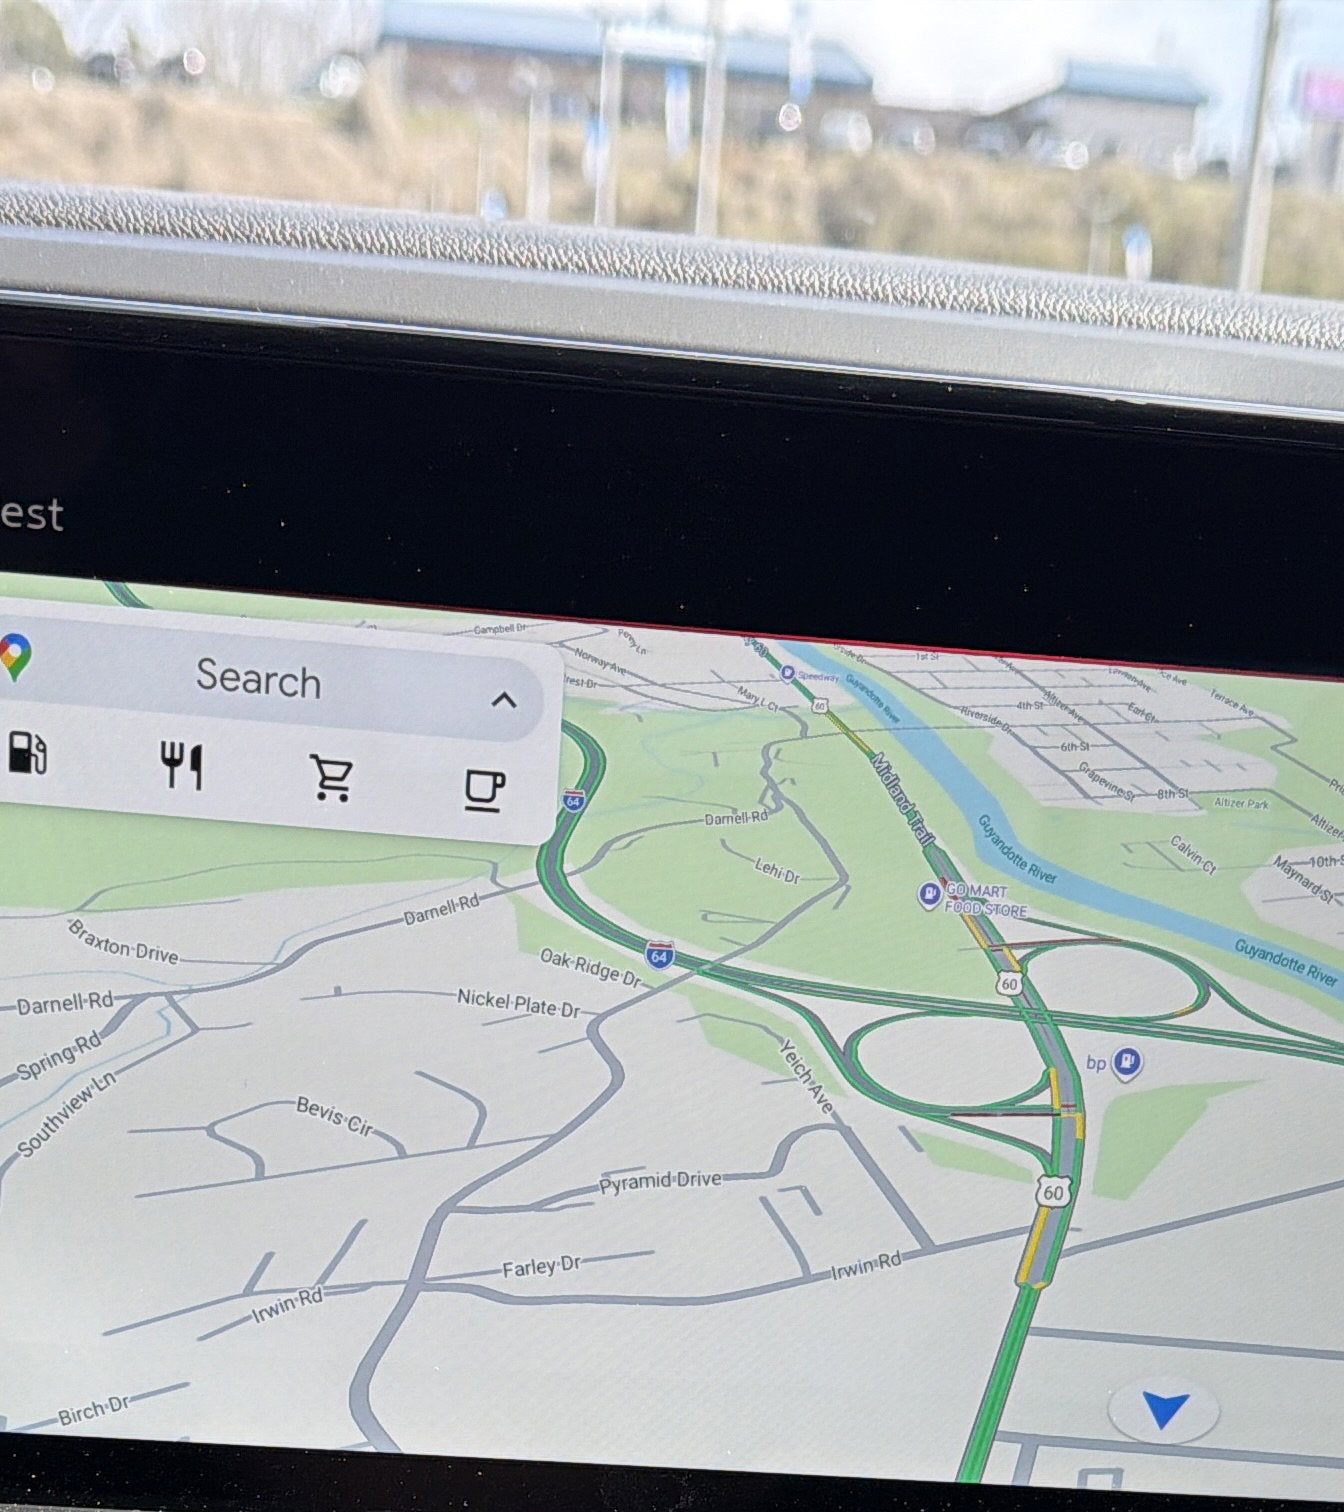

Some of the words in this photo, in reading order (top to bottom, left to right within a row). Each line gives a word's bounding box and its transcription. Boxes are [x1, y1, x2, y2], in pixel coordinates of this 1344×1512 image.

[474, 624, 516, 636] Campbell
[517, 623, 527, 633] Dr
[575, 647, 609, 670] Norway
[610, 662, 627, 676] Ave
[197, 657, 321, 700] Search
[563, 673, 586, 686] rest
[586, 678, 597, 688] Dr
[798, 671, 840, 684] Speedway
[737, 685, 758, 704] Mary
[815, 702, 825, 711] 60
[846, 673, 884, 709] Guyandotte
[883, 706, 901, 723] River
[1017, 701, 1032, 711] 4th
[1034, 701, 1044, 710] St
[1210, 688, 1240, 708] Terrace
[1239, 704, 1255, 717] Ave
[960, 706, 1002, 728] Riverside
[1001, 722, 1015, 736] Dr
[1061, 741, 1074, 752] 6th
[1077, 741, 1090, 752] St
[1079, 762, 1124, 796] Grapevine
[1123, 789, 1136, 803] St
[1157, 788, 1174, 799] 8th
[1178, 788, 1190, 799] St
[566, 797, 580, 807] 64
[872, 752, 916, 815] Midland
[907, 810, 936, 848] Trail
[1215, 797, 1245, 810] Altizer
[1247, 798, 1269, 811] Park
[705, 811, 747, 826] Darnell
[751, 809, 769, 823] Rd
[978, 814, 1027, 875] Guyandotte
[1027, 862, 1058, 884] River
[1170, 835, 1204, 864] Calvin
[1202, 859, 1217, 876] Ct
[1310, 856, 1334, 869] 10th
[755, 857, 783, 880] Lehi
[785, 867, 801, 886] Dr
[1273, 854, 1322, 896] Maynard
[1319, 889, 1335, 906] St
[946, 882, 966, 897] GO
[969, 884, 1007, 898] MART
[404, 899, 457, 926] Darnell
[458, 892, 481, 910] Rd
[945, 900, 982, 915] FOOD
[985, 903, 1027, 918] STORE
[68, 918, 130, 957] Braxton
[135, 943, 179, 966] Drive
[540, 947, 570, 968] Oak
[575, 957, 621, 985] Ridge
[622, 971, 642, 989] Dr
[651, 950, 668, 964] 64
[1235, 939, 1306, 976] Guyandotte
[1306, 961, 1339, 988] River
[1002, 977, 1018, 991] 60
[17, 993, 86, 1016] Darnell
[88, 990, 114, 1009] Rd
[457, 988, 511, 1011] Nickel
[514, 995, 557, 1016] Plate
[561, 1002, 581, 1019] Dr
[16, 1048, 77, 1081] Spring
[75, 1030, 102, 1056] Rd
[1086, 1054, 1107, 1072] bp
[781, 1039, 813, 1085] Yeich
[806, 1081, 834, 1115] Ave
[17, 1085, 94, 1158] Southview
[91, 1070, 117, 1091] Ln
[296, 1096, 344, 1126] Bevis
[346, 1114, 374, 1138] Cir
[600, 1171, 672, 1196] Pyramid
[676, 1170, 722, 1188] Drive
[1043, 1185, 1064, 1201] 60
[502, 1257, 556, 1279] Farley
[561, 1254, 581, 1271] Dr
[831, 1261, 873, 1281] Irwin
[879, 1250, 902, 1268] Rd
[252, 1296, 296, 1324] Irwin
[299, 1288, 323, 1306] Rd
[58, 1401, 106, 1427] Birch
[108, 1395, 130, 1413] Dr
